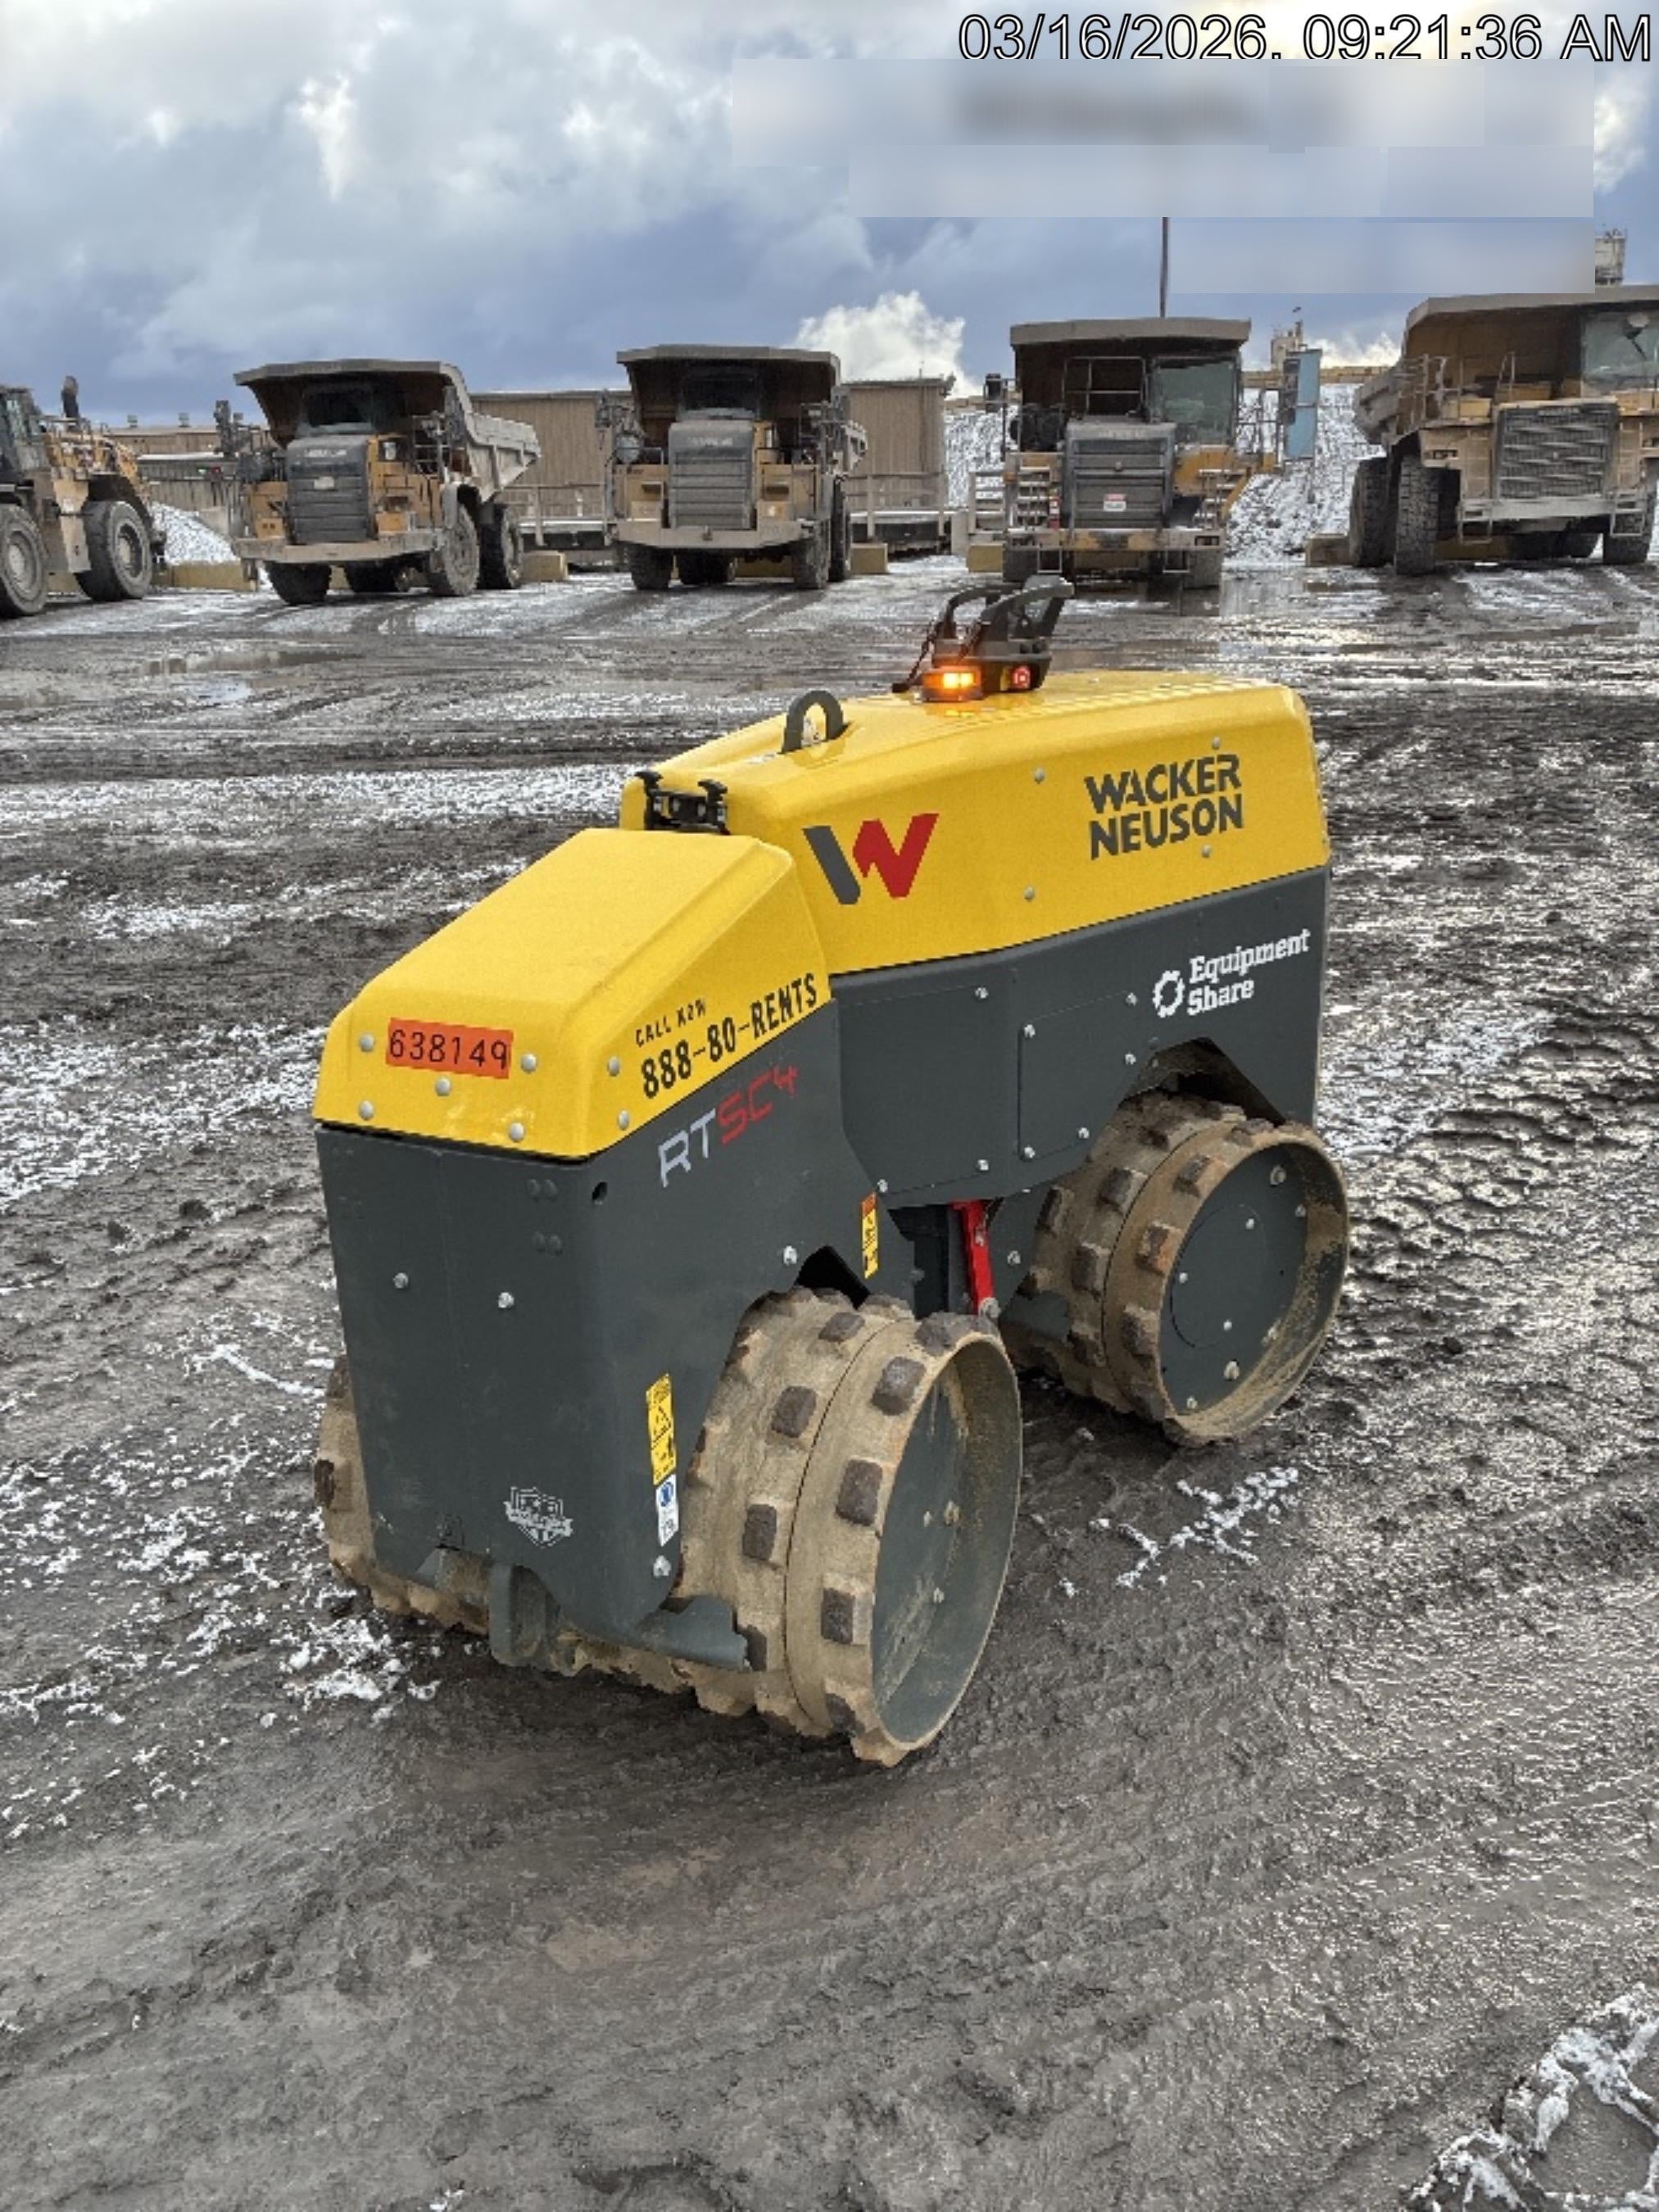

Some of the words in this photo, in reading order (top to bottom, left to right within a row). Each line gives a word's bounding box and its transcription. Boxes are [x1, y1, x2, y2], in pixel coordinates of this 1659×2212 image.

[1084, 754, 1242, 814] WACKER
[1090, 793, 1244, 860] NEUSON
[1190, 928, 1311, 983] Equipment
[1187, 980, 1254, 1016] Share
[389, 1028, 507, 1070] 638149
[636, 1015, 672, 1048] CALL
[641, 972, 817, 1099] 888-80-RENTS
